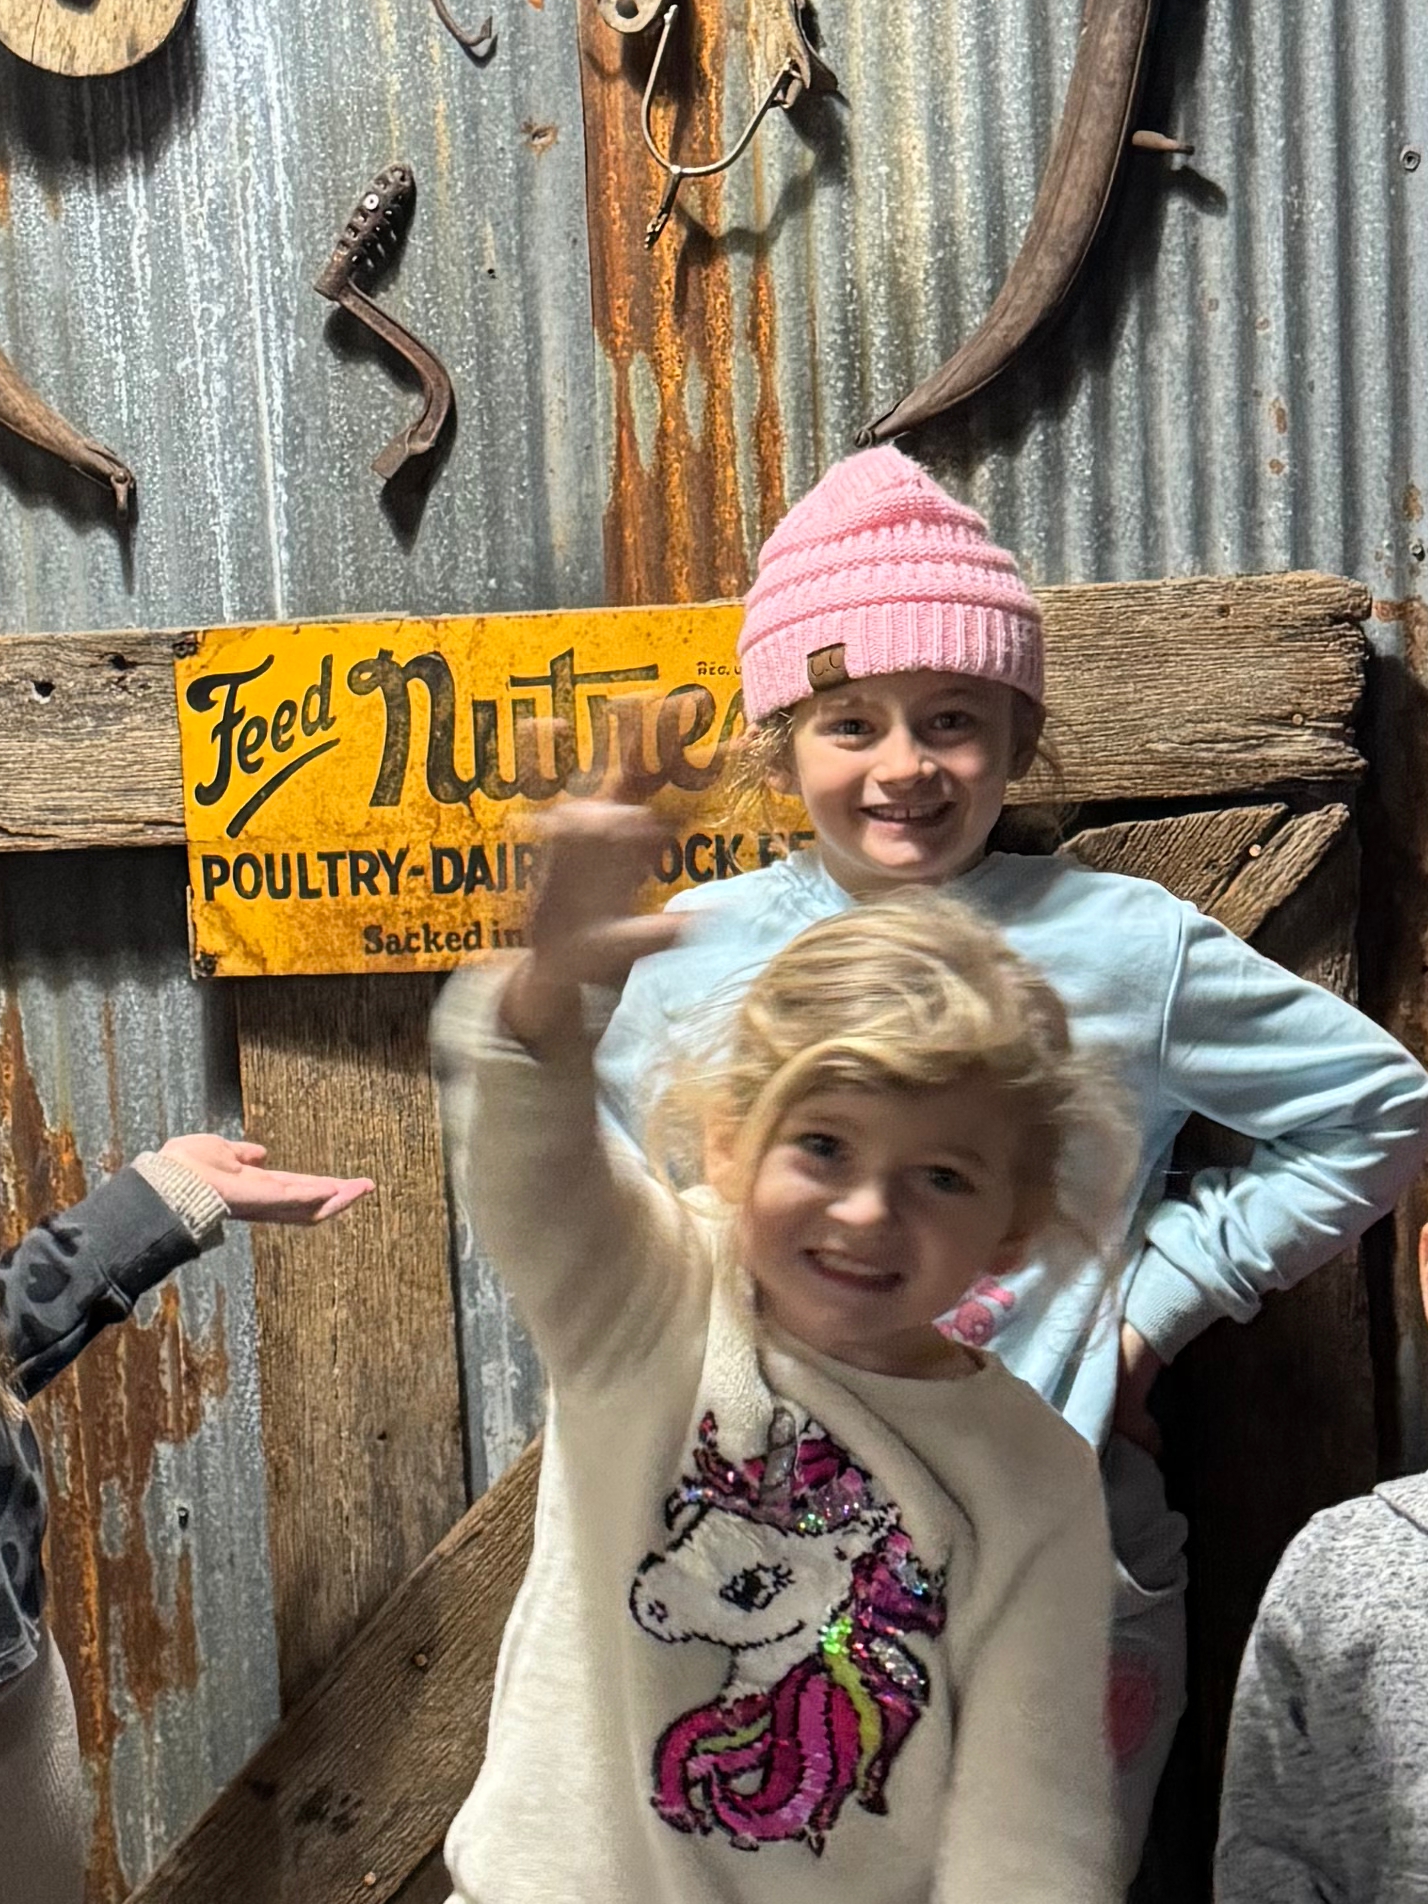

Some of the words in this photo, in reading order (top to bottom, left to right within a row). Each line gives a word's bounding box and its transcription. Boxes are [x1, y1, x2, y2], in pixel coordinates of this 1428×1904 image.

[185, 653, 338, 807] Feed
[346, 647, 745, 808] Nutre
[364, 921, 482, 956] Sacked
